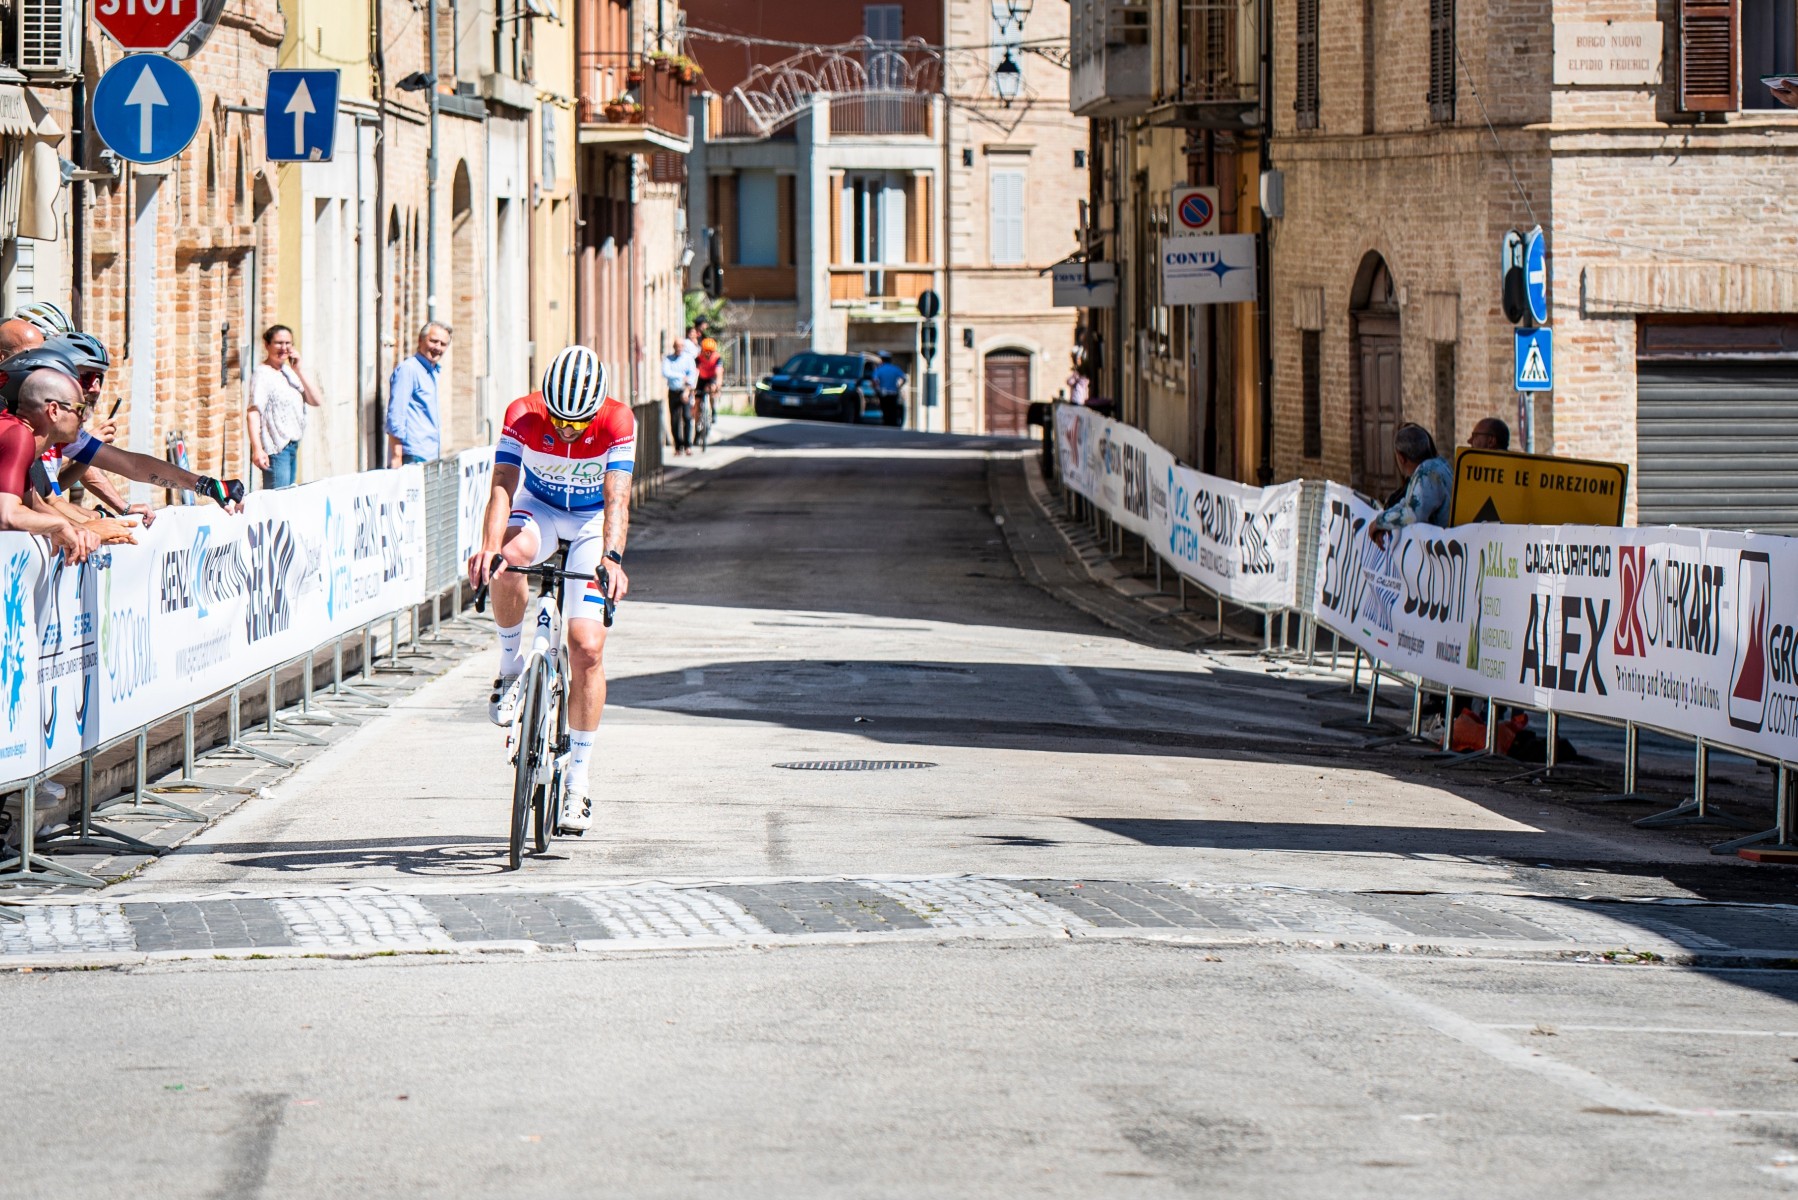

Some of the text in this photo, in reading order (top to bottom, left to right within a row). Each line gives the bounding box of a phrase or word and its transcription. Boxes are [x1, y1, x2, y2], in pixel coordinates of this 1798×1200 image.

[1576, 35, 1642, 48] BORGO NUOVO
[1568, 59, 1649, 71] ELPIDIO FEDERICI
[1166, 251, 1216, 265] CONTI
[1054, 273, 1084, 283] CONT
[1466, 465, 1615, 496] TUTTE LE DIREZIONI
[1525, 543, 1611, 578] CALZATURIFICIO
[1483, 596, 1501, 617] SERVIZI
[1642, 556, 1723, 656] OVERKART
[1482, 626, 1513, 650] AMBIENTALI
[1519, 593, 1611, 696] ALEX
[1479, 656, 1507, 681] INTEGRATI
[1615, 665, 1720, 711] Printing and Packaging Solutions
